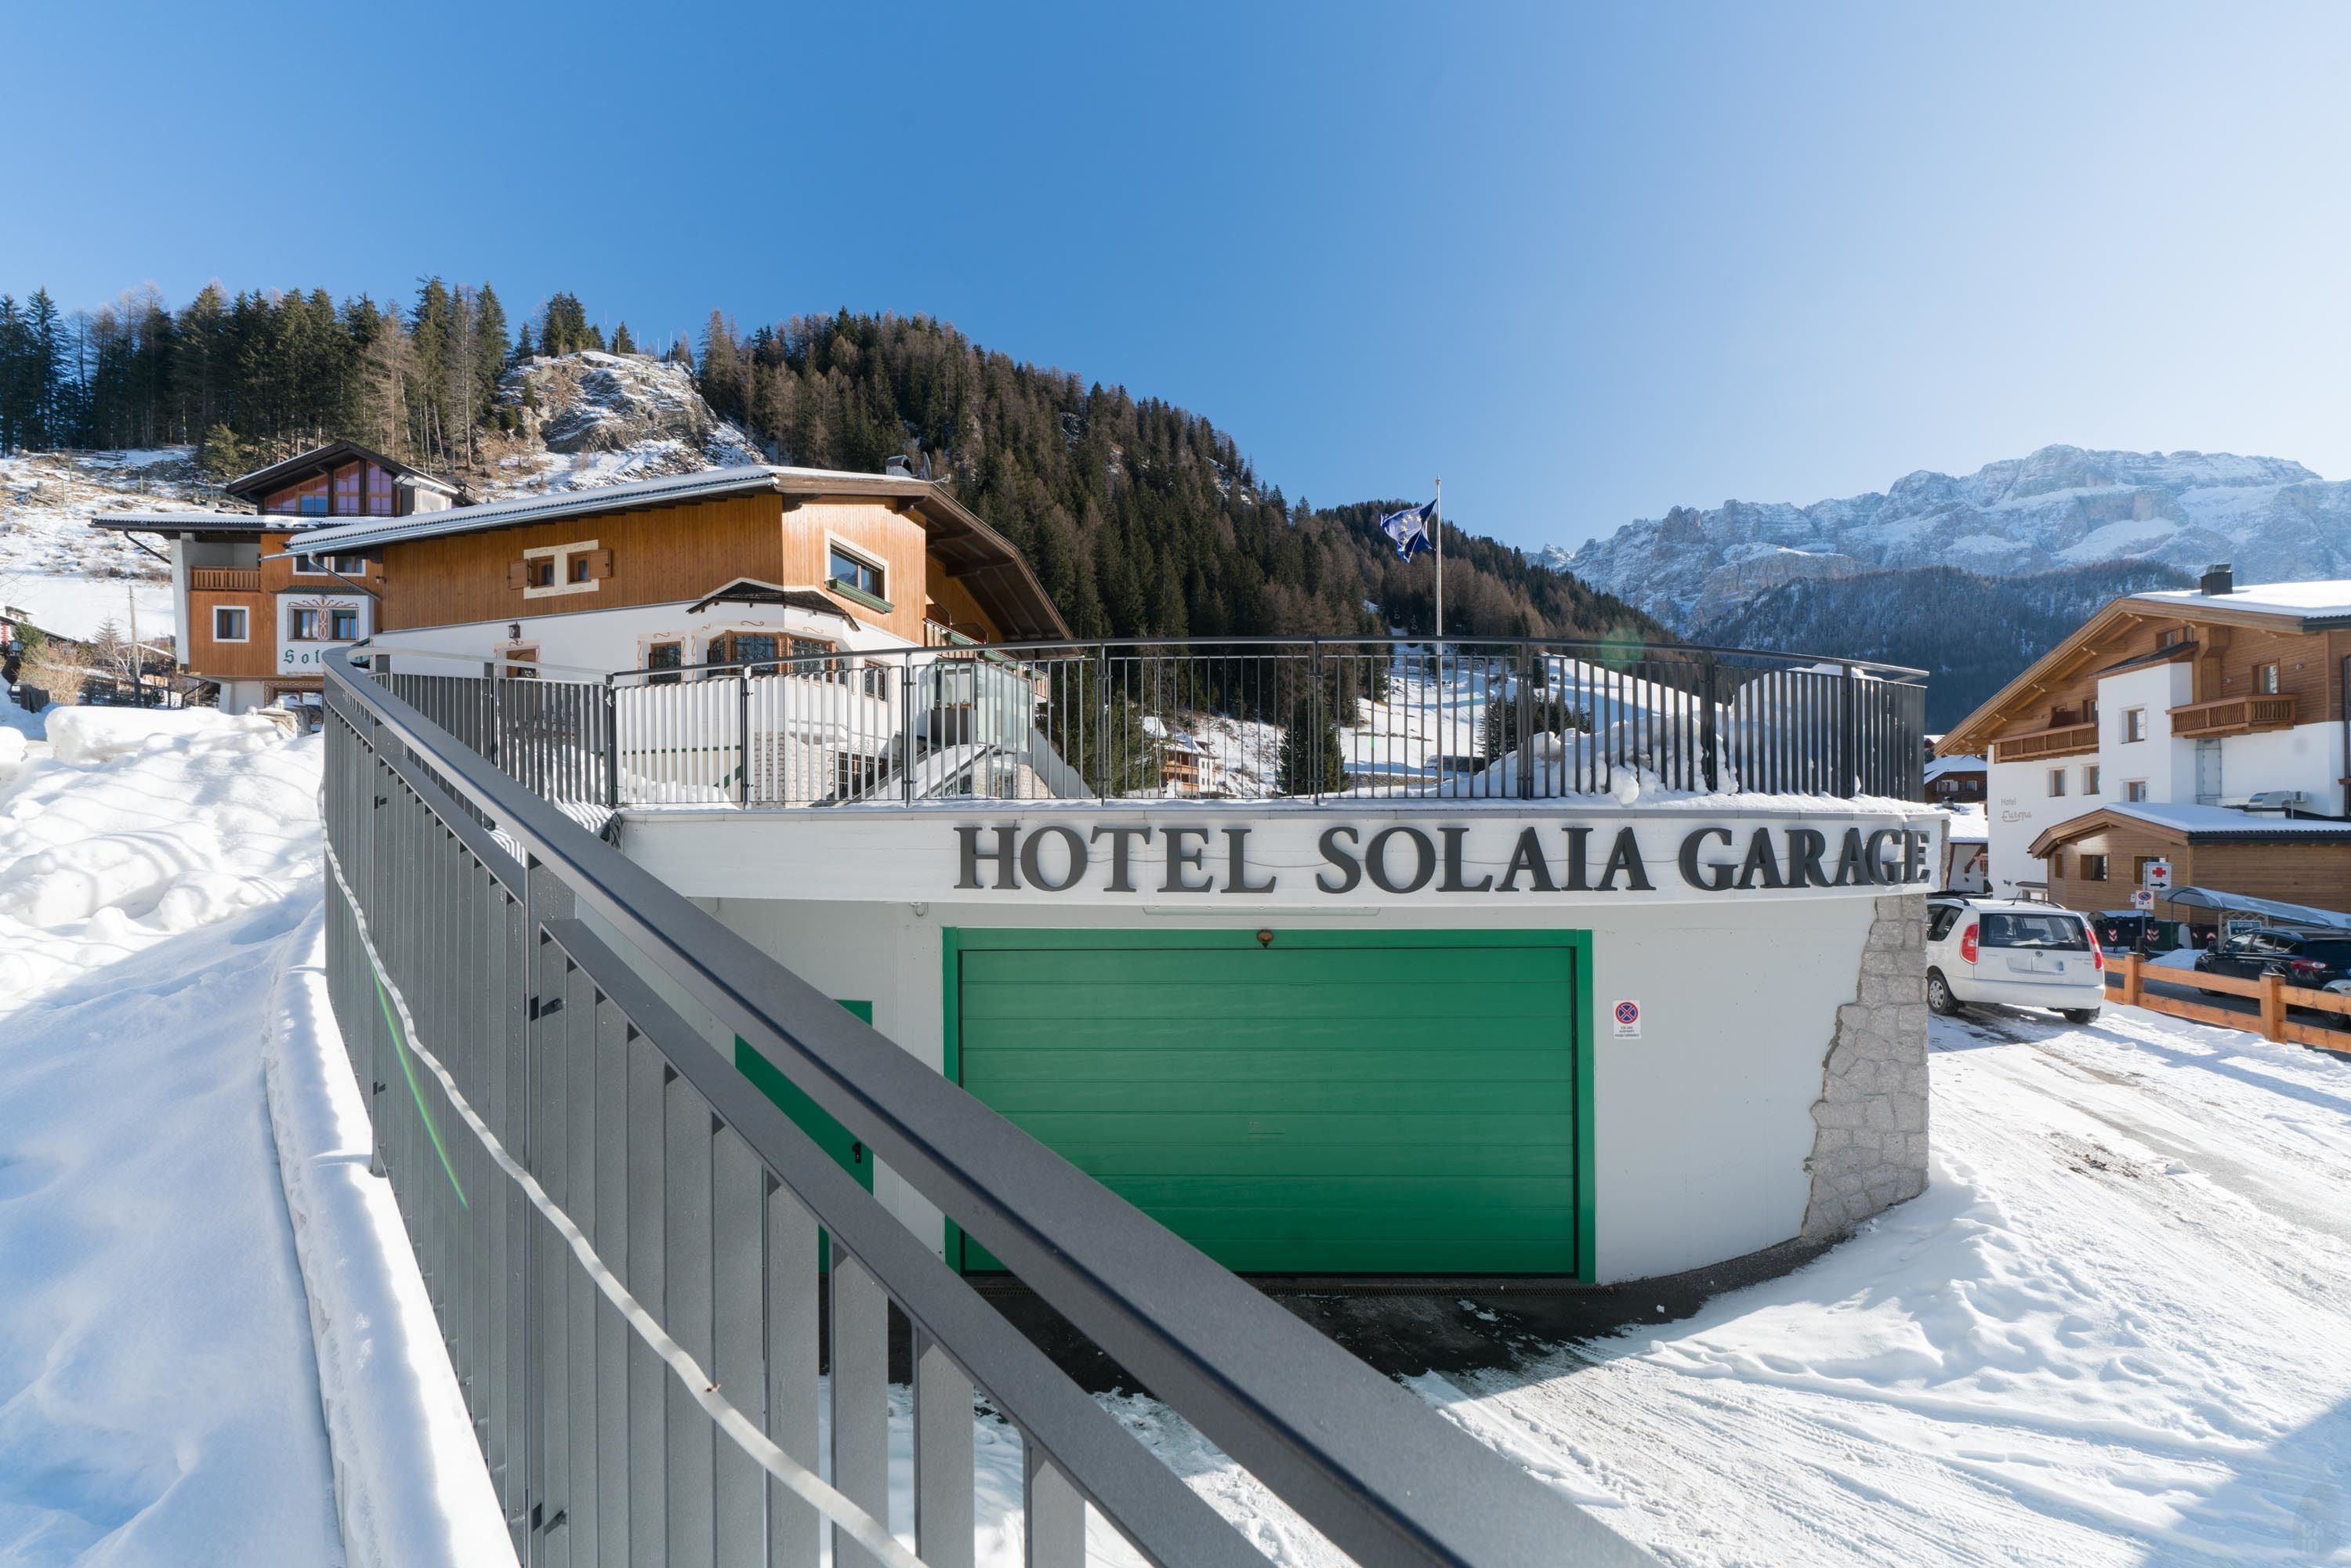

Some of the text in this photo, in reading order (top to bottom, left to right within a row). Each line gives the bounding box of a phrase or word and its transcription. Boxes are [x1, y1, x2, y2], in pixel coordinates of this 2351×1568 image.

[2001, 797, 2017, 806] Hotel
[2001, 810, 2032, 823] Europa
[953, 825, 1931, 893] HOTEL SOLAIA GARAGE
